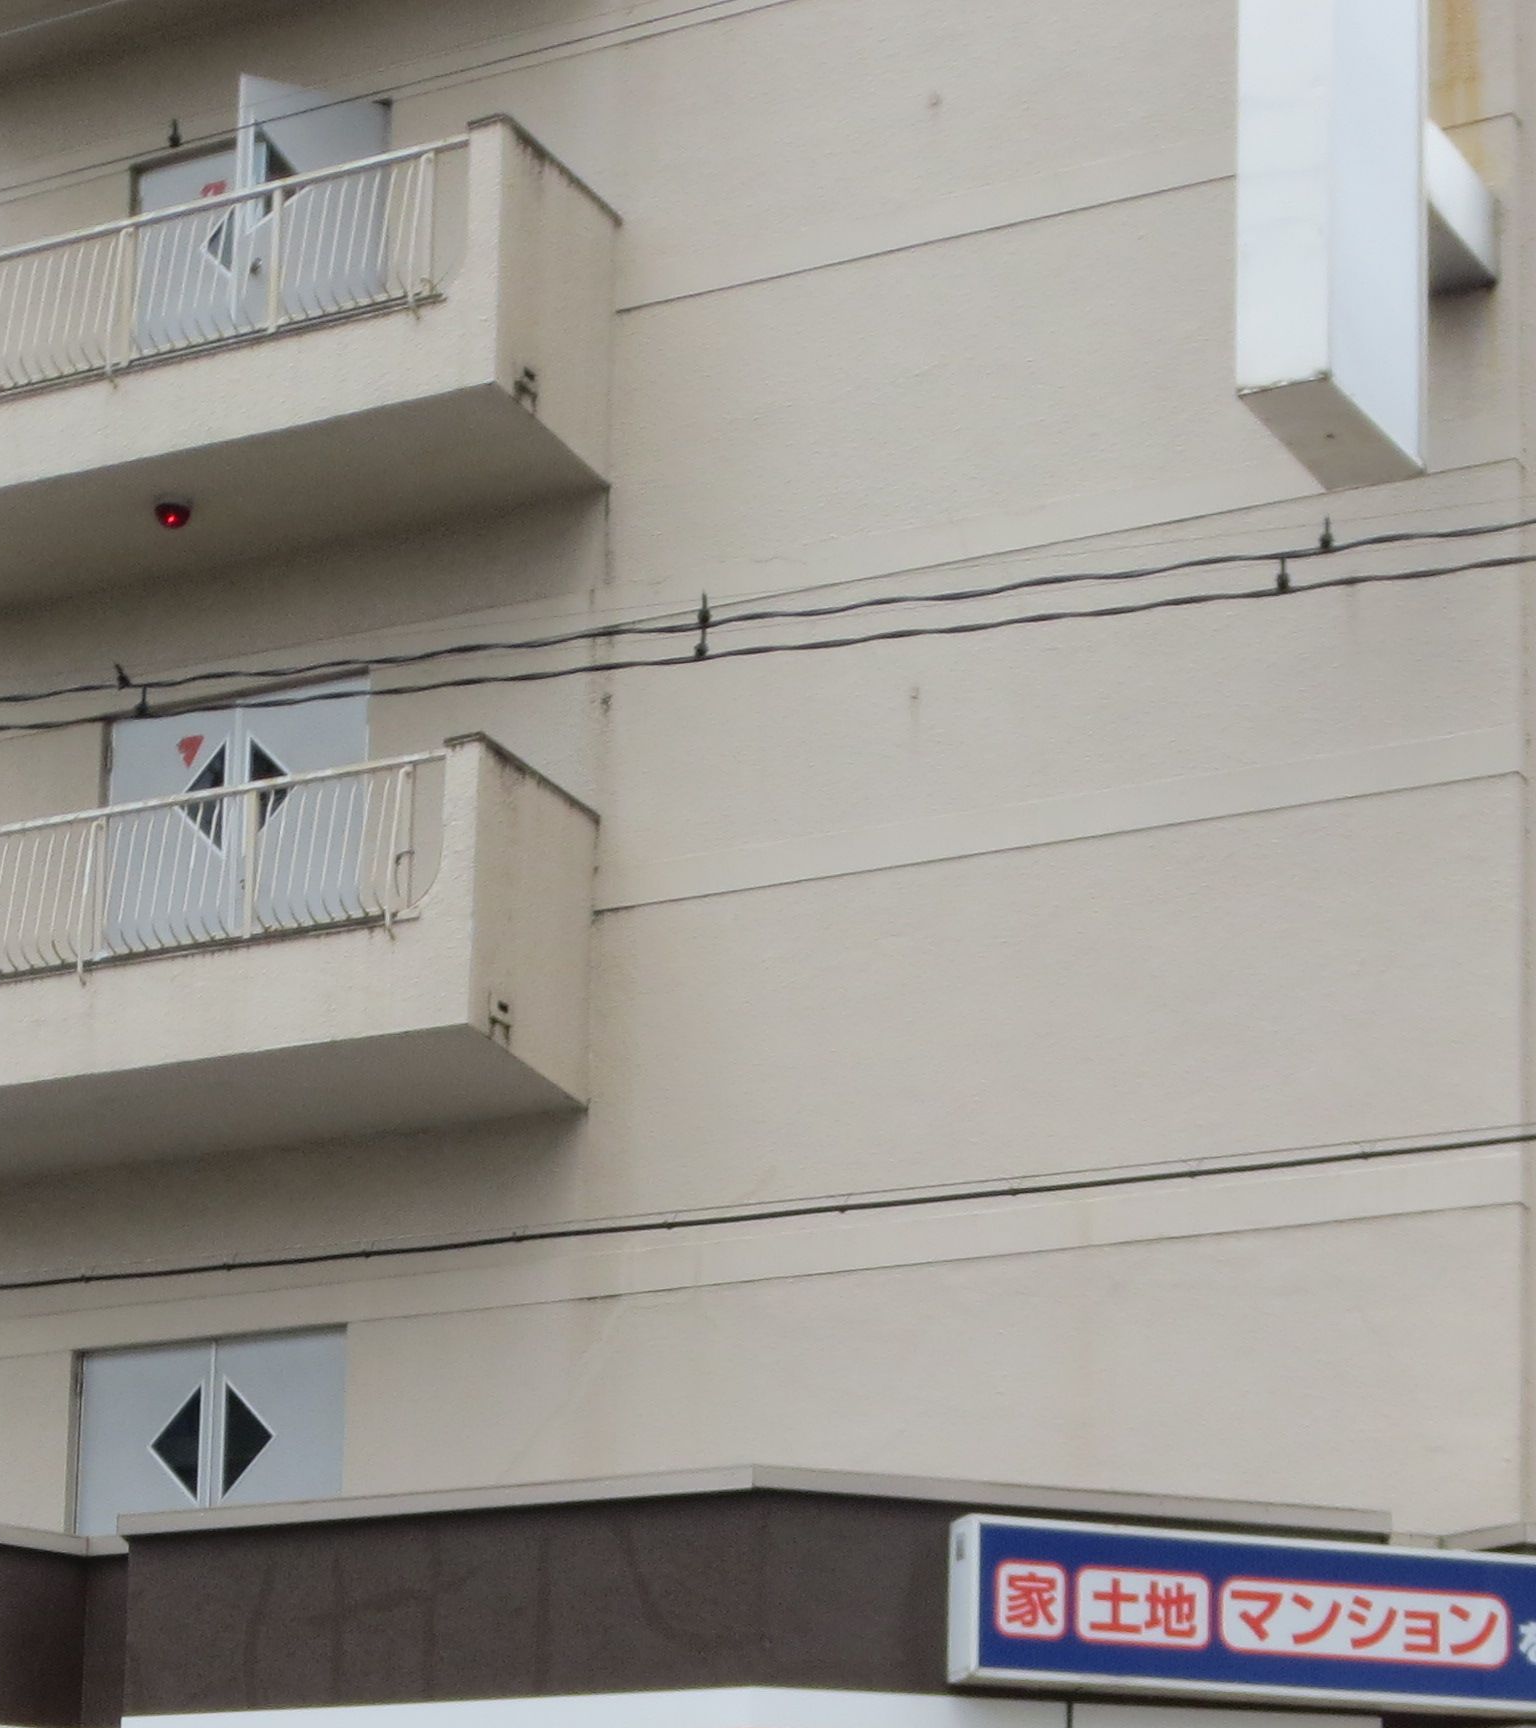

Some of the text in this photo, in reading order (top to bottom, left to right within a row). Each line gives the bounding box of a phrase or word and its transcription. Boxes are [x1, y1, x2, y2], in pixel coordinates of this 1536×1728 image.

[1004, 1572, 1059, 1628] 家
[1089, 1578, 1197, 1638] 土地
[1231, 1589, 1497, 1656] マンション
